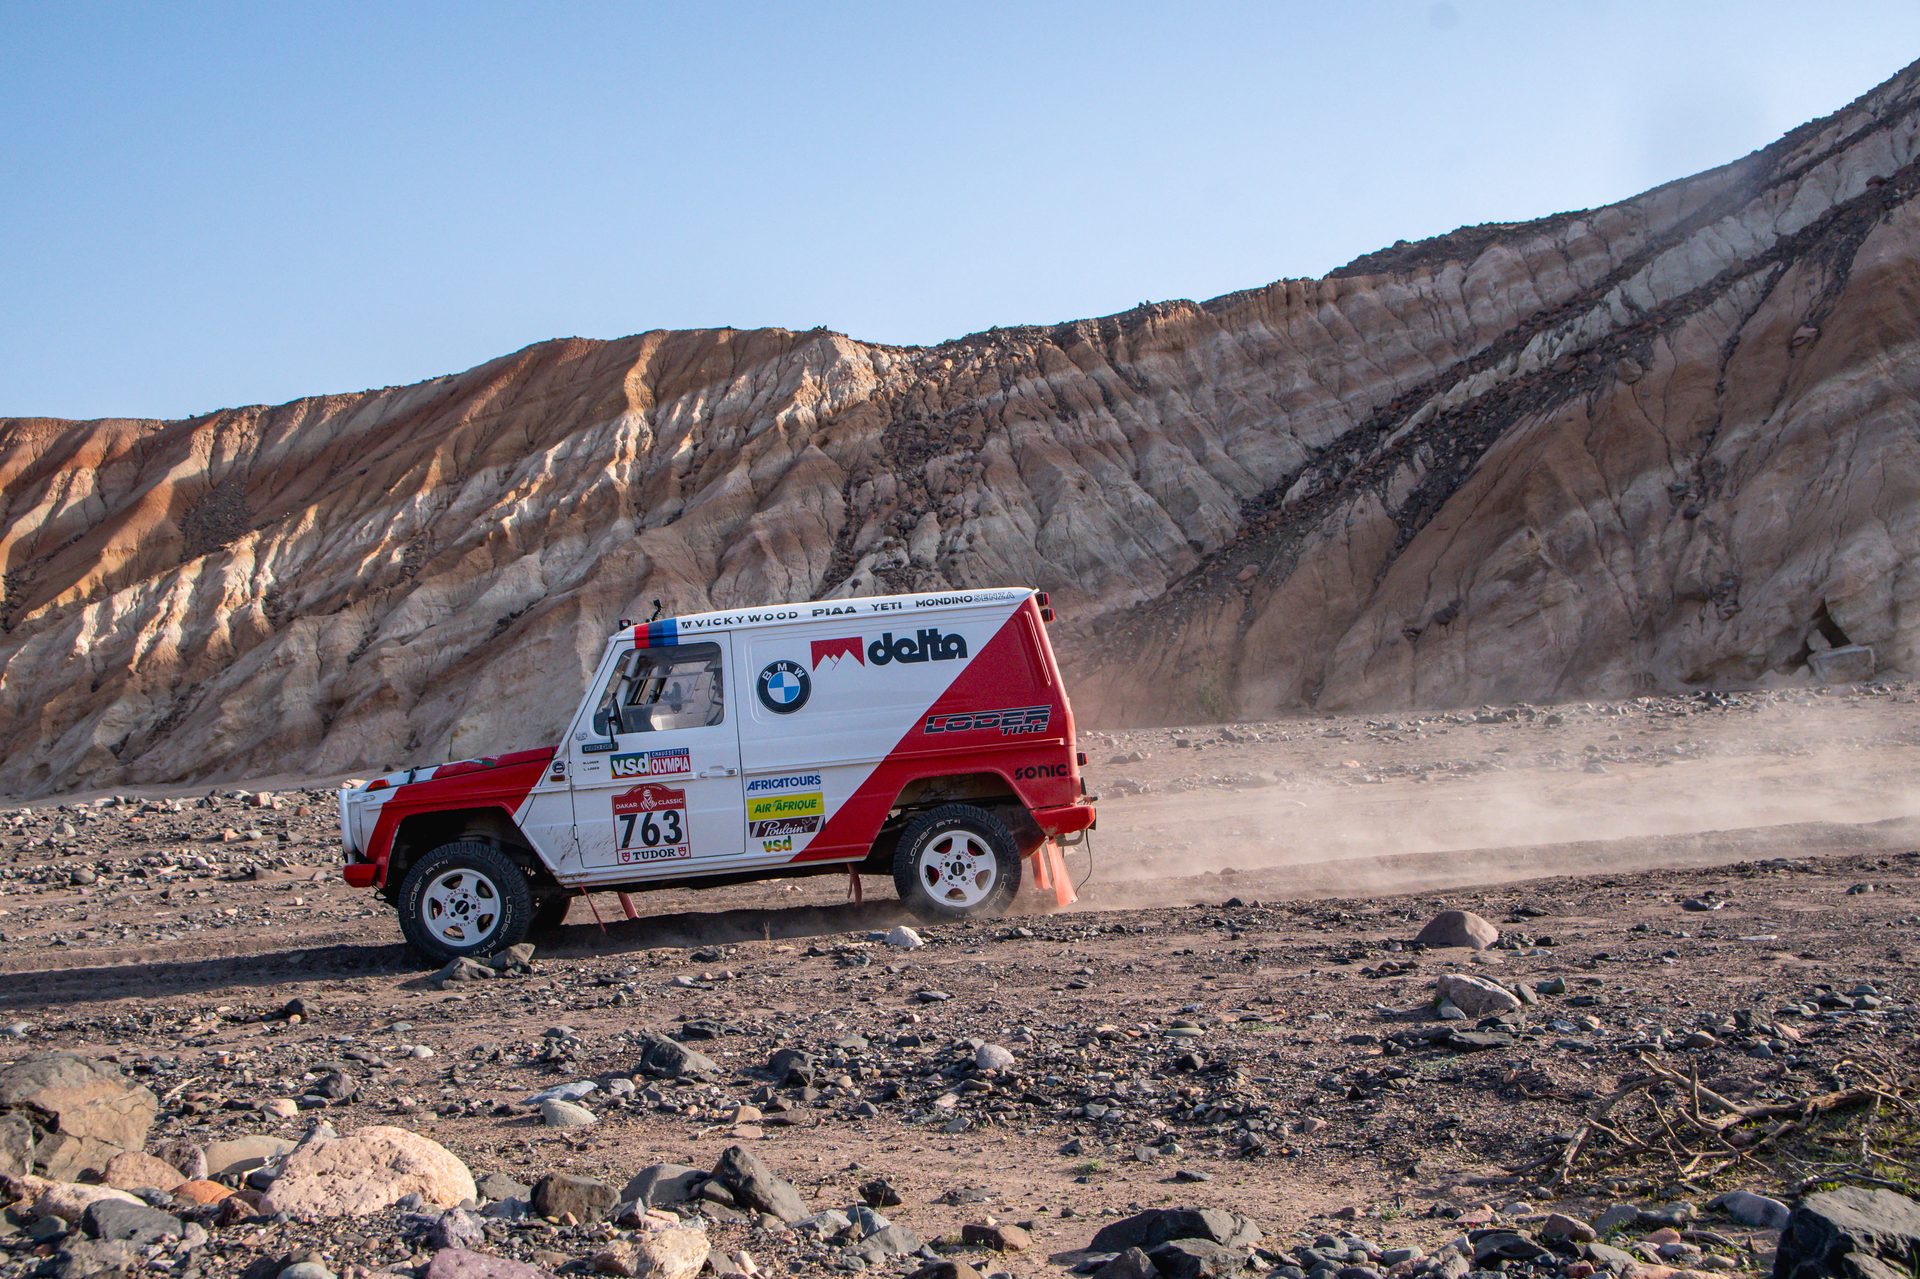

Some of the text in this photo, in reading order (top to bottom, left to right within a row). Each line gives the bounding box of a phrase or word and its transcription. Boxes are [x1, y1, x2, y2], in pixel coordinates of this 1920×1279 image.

[812, 606, 857, 617] PIAA
[871, 601, 902, 611] YETI
[695, 611, 798, 627] VICKYWOOD
[867, 628, 968, 666] delta
[762, 662, 805, 681] BMW
[924, 704, 1052, 735] LODER
[1000, 723, 1047, 736] TIRE
[651, 748, 688, 757] CHAUSSETTES
[612, 752, 690, 777] vsd OLYMPIA
[746, 775, 821, 791] AFRICATOURS
[616, 802, 638, 810] DAKAR
[754, 799, 817, 814] AIR AFRIQUE
[619, 810, 683, 848] 763
[762, 820, 803, 837] Poulain
[762, 835, 792, 853] vsd
[633, 848, 676, 860] TUDOR
